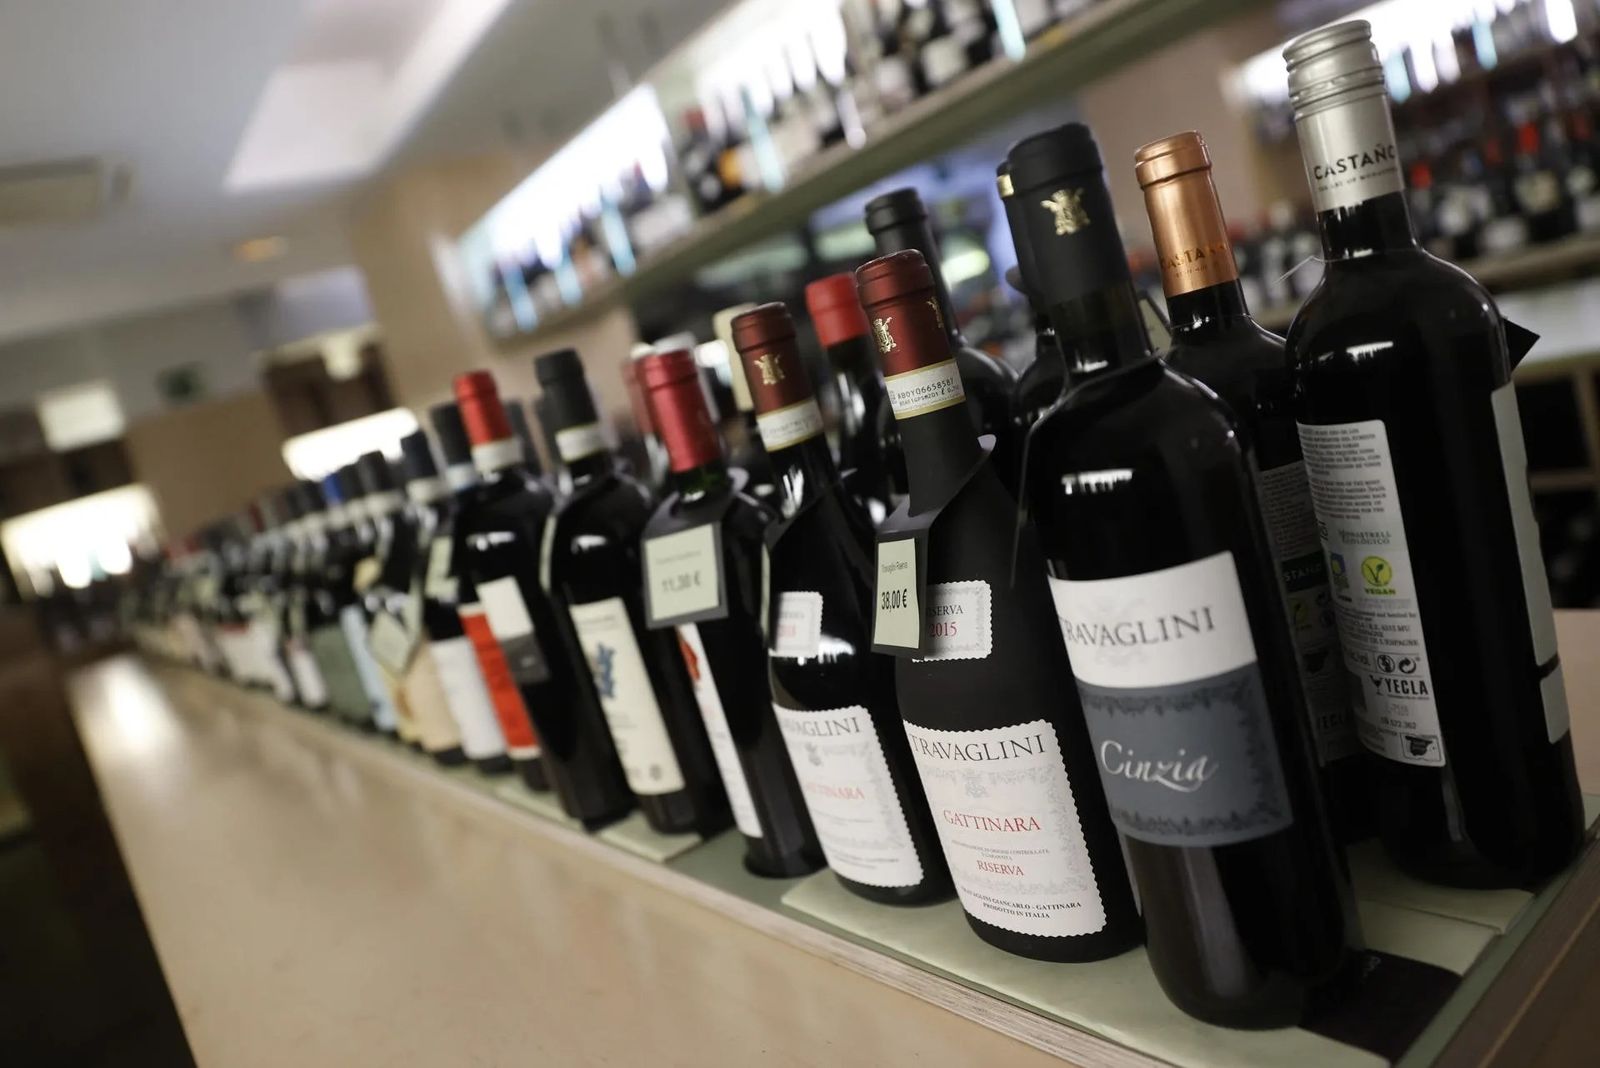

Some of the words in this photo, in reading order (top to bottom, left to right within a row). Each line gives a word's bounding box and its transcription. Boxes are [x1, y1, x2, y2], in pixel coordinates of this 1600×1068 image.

[881, 589, 900, 612] 38,00
[902, 588, 908, 608] €
[928, 621, 958, 637] 2015
[1384, 678, 1429, 696] YECLA
[908, 733, 1046, 762] TRAVAGLINI
[1101, 739, 1219, 793] Cinzia
[943, 809, 1042, 833] GATTINARA
[976, 860, 1025, 876] RISERVA
[982, 902, 1015, 916] PRODOTTO
[1025, 911, 1051, 919] ITALIA
[992, 898, 1031, 910] GIANCARLO
[1036, 901, 1082, 911] GATTINARA
